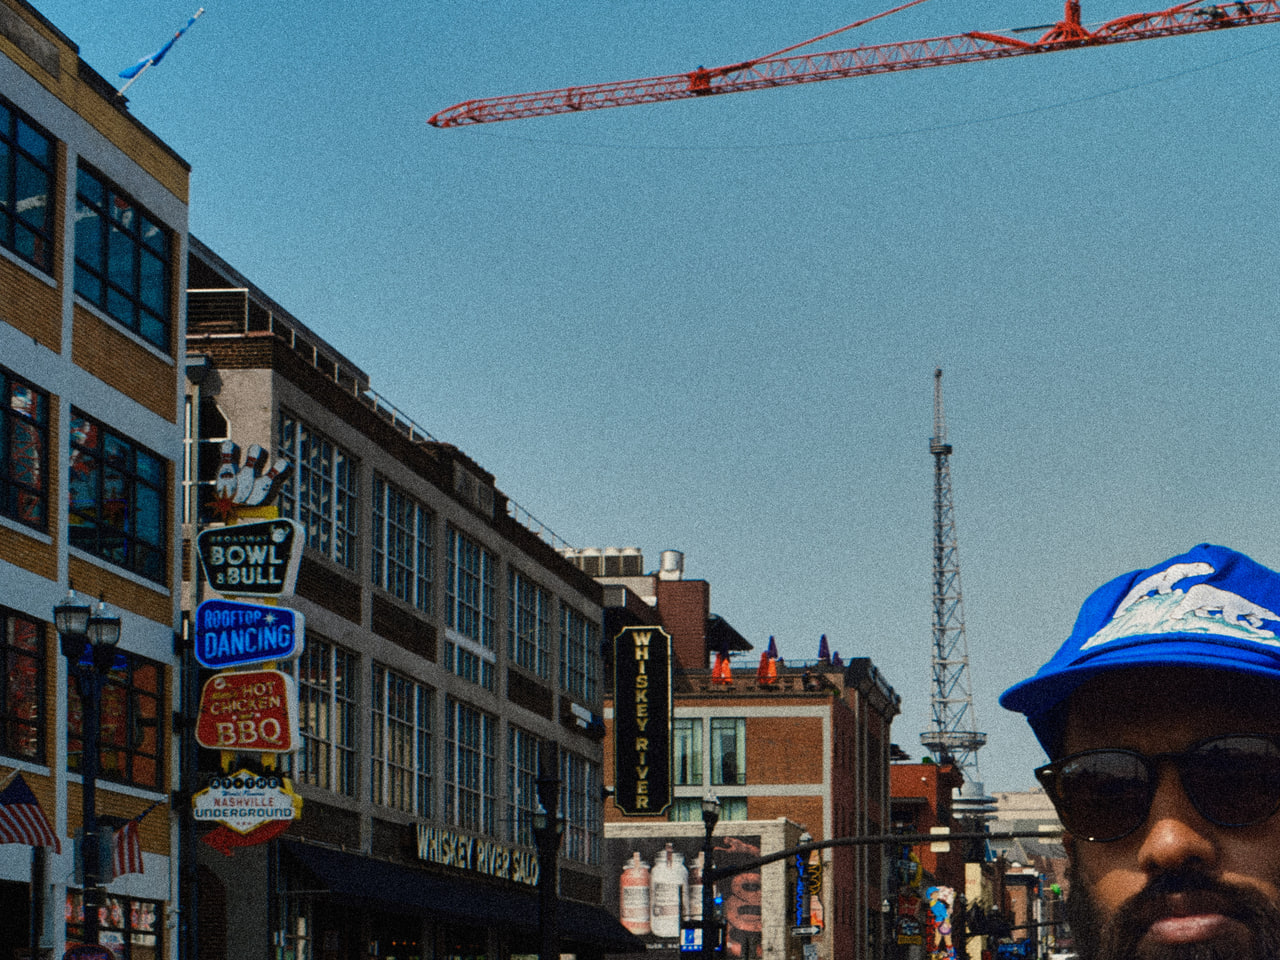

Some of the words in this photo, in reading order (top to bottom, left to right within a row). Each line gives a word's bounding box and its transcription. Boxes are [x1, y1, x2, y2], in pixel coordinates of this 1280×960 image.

[210, 545, 284, 566] BOWL
[215, 572, 225, 585] &
[227, 567, 282, 585] BULL
[204, 609, 262, 629] ROOFTOP
[204, 625, 291, 660] DANCING
[242, 681, 276, 698] HOT
[632, 631, 652, 732] WHISKEY
[209, 695, 281, 716] CHICKEN
[216, 718, 283, 746] BBQ
[635, 737, 649, 809] RIVER
[194, 807, 293, 818] UNDERGROUND
[213, 797, 275, 807] NASHVILLE
[416, 823, 474, 870] WHISKEY
[476, 840, 511, 880] RIVER
[512, 849, 540, 887] SALO
